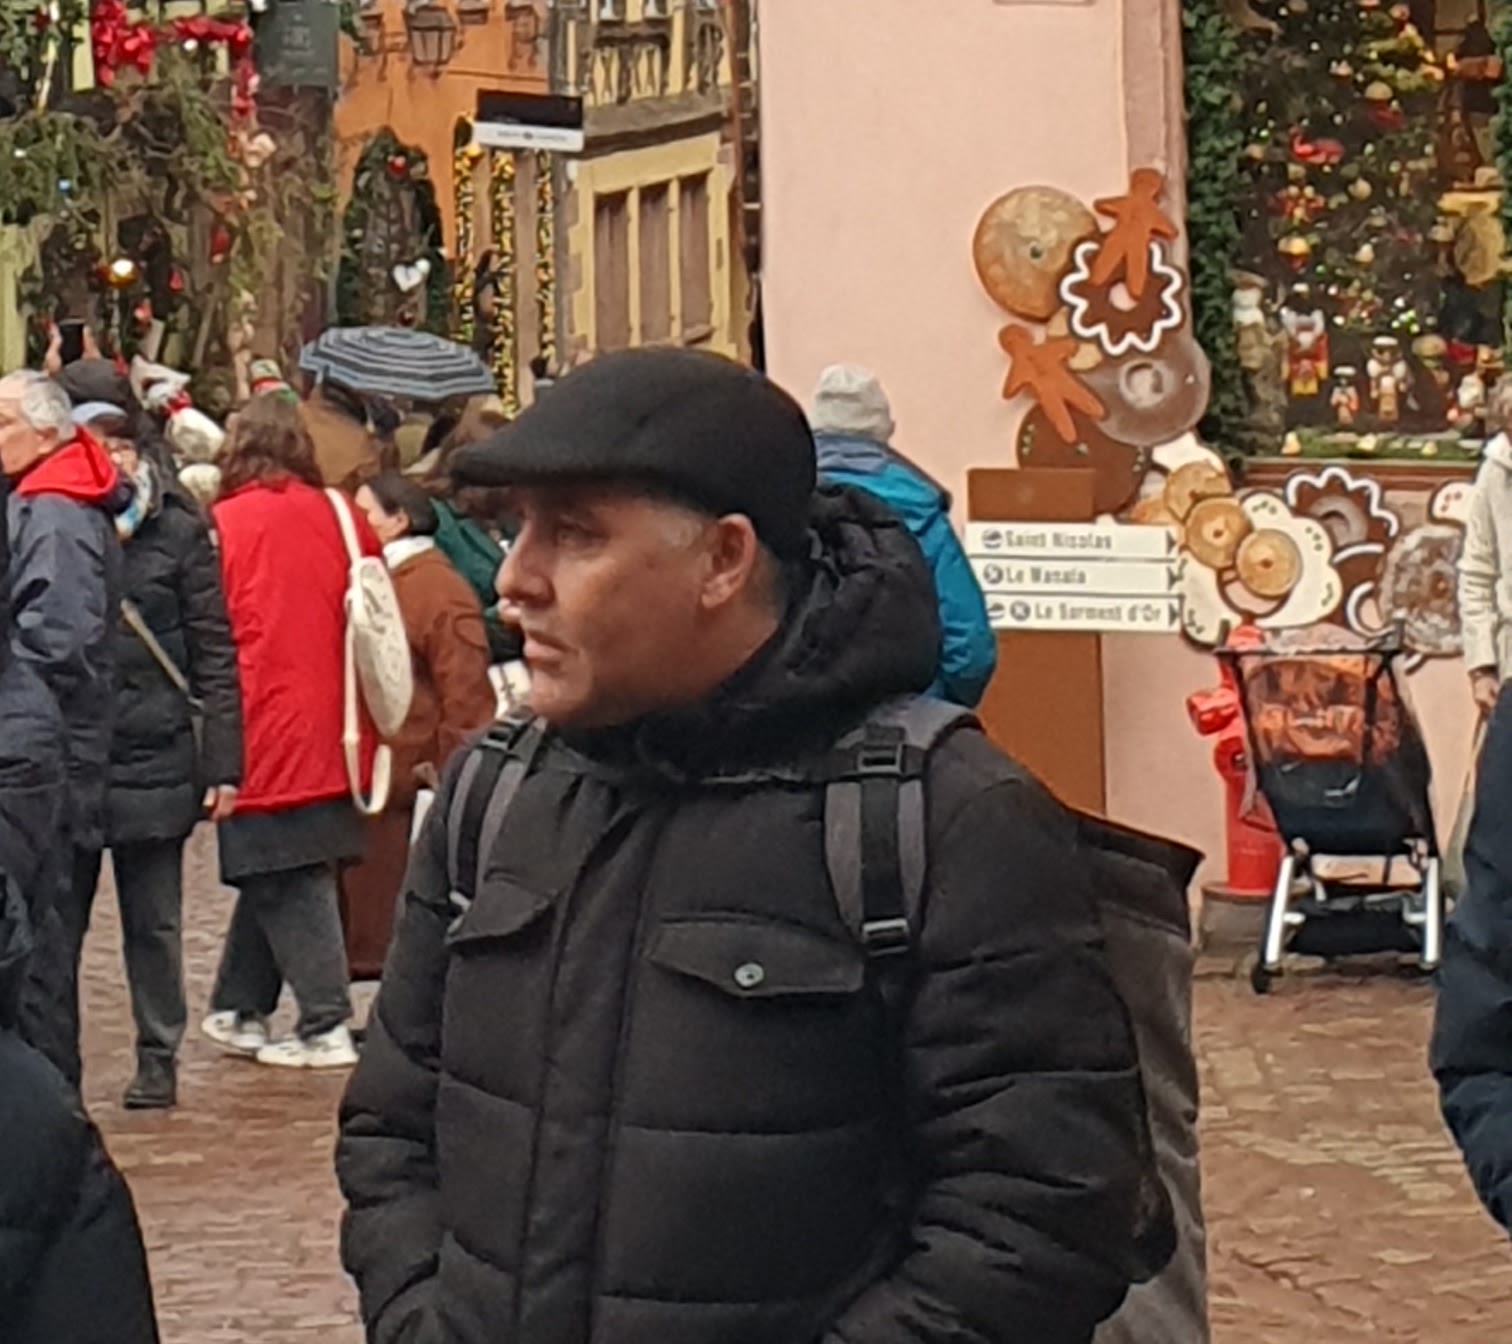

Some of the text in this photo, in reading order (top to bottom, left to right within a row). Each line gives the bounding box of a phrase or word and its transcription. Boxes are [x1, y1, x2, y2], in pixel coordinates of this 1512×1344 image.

[1005, 531, 1112, 550] Saint Nicolas
[1006, 567, 1025, 584] Le
[1035, 603, 1053, 619] Le
[1128, 604, 1162, 622] d'Or
